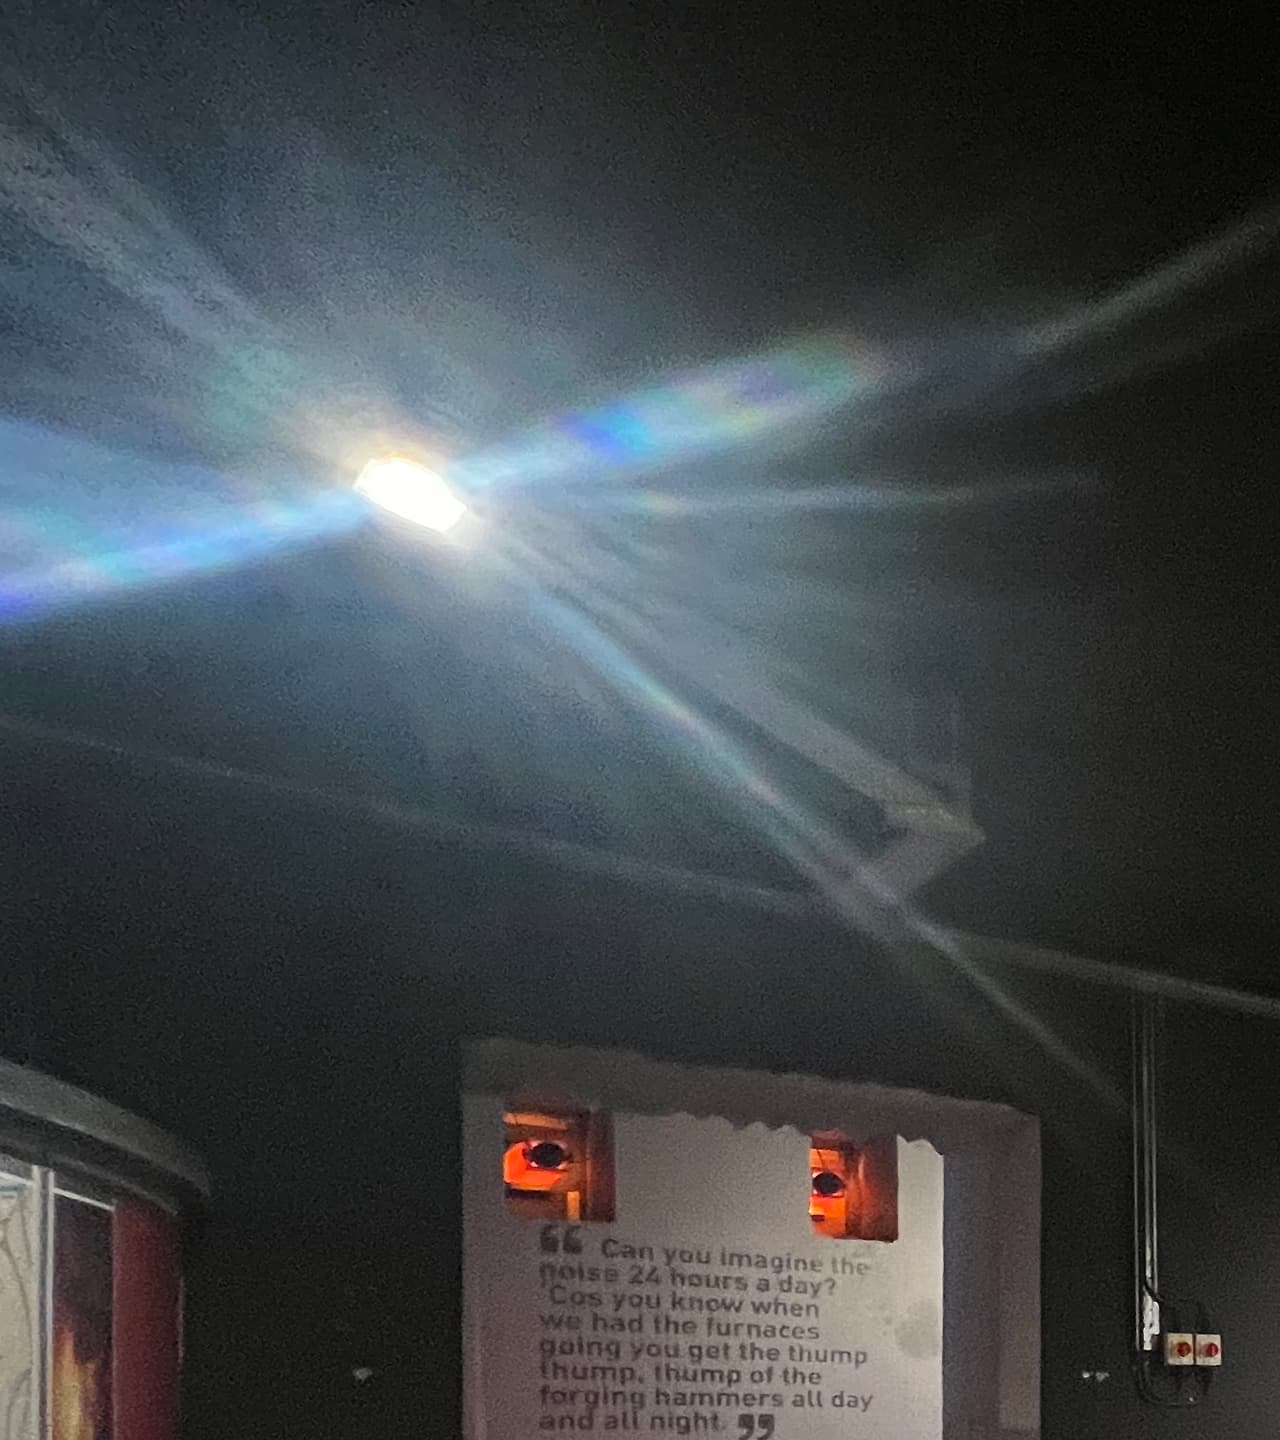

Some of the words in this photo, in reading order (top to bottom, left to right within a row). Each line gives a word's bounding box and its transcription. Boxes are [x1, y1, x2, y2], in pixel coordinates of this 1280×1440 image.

[601, 1238, 654, 1261] Can
[663, 1247, 710, 1266] you
[720, 1247, 824, 1273] imagine
[831, 1257, 870, 1275] the
[539, 1262, 619, 1282] noise
[629, 1265, 660, 1284] 24
[670, 1266, 748, 1290] hours
[756, 1277, 770, 1292] a
[779, 1275, 836, 1298] day?
[613, 1293, 660, 1311] you
[671, 1291, 743, 1312] know
[751, 1298, 819, 1317] when
[539, 1313, 581, 1330] we
[593, 1312, 643, 1332] had
[654, 1314, 697, 1334] the
[706, 1317, 820, 1339] furnaces
[539, 1335, 620, 1361] going
[631, 1343, 679, 1361] you
[688, 1342, 730, 1362] get
[739, 1342, 780, 1361] the
[789, 1344, 868, 1368] thump
[655, 1363, 741, 1387] thump
[751, 1366, 774, 1383] of
[783, 1366, 821, 1385] the
[539, 1385, 644, 1409] forging
[655, 1388, 783, 1407] hammers
[791, 1391, 823, 1407] all
[832, 1391, 873, 1412] day
[539, 1411, 594, 1430] and
[605, 1411, 639, 1430] all
